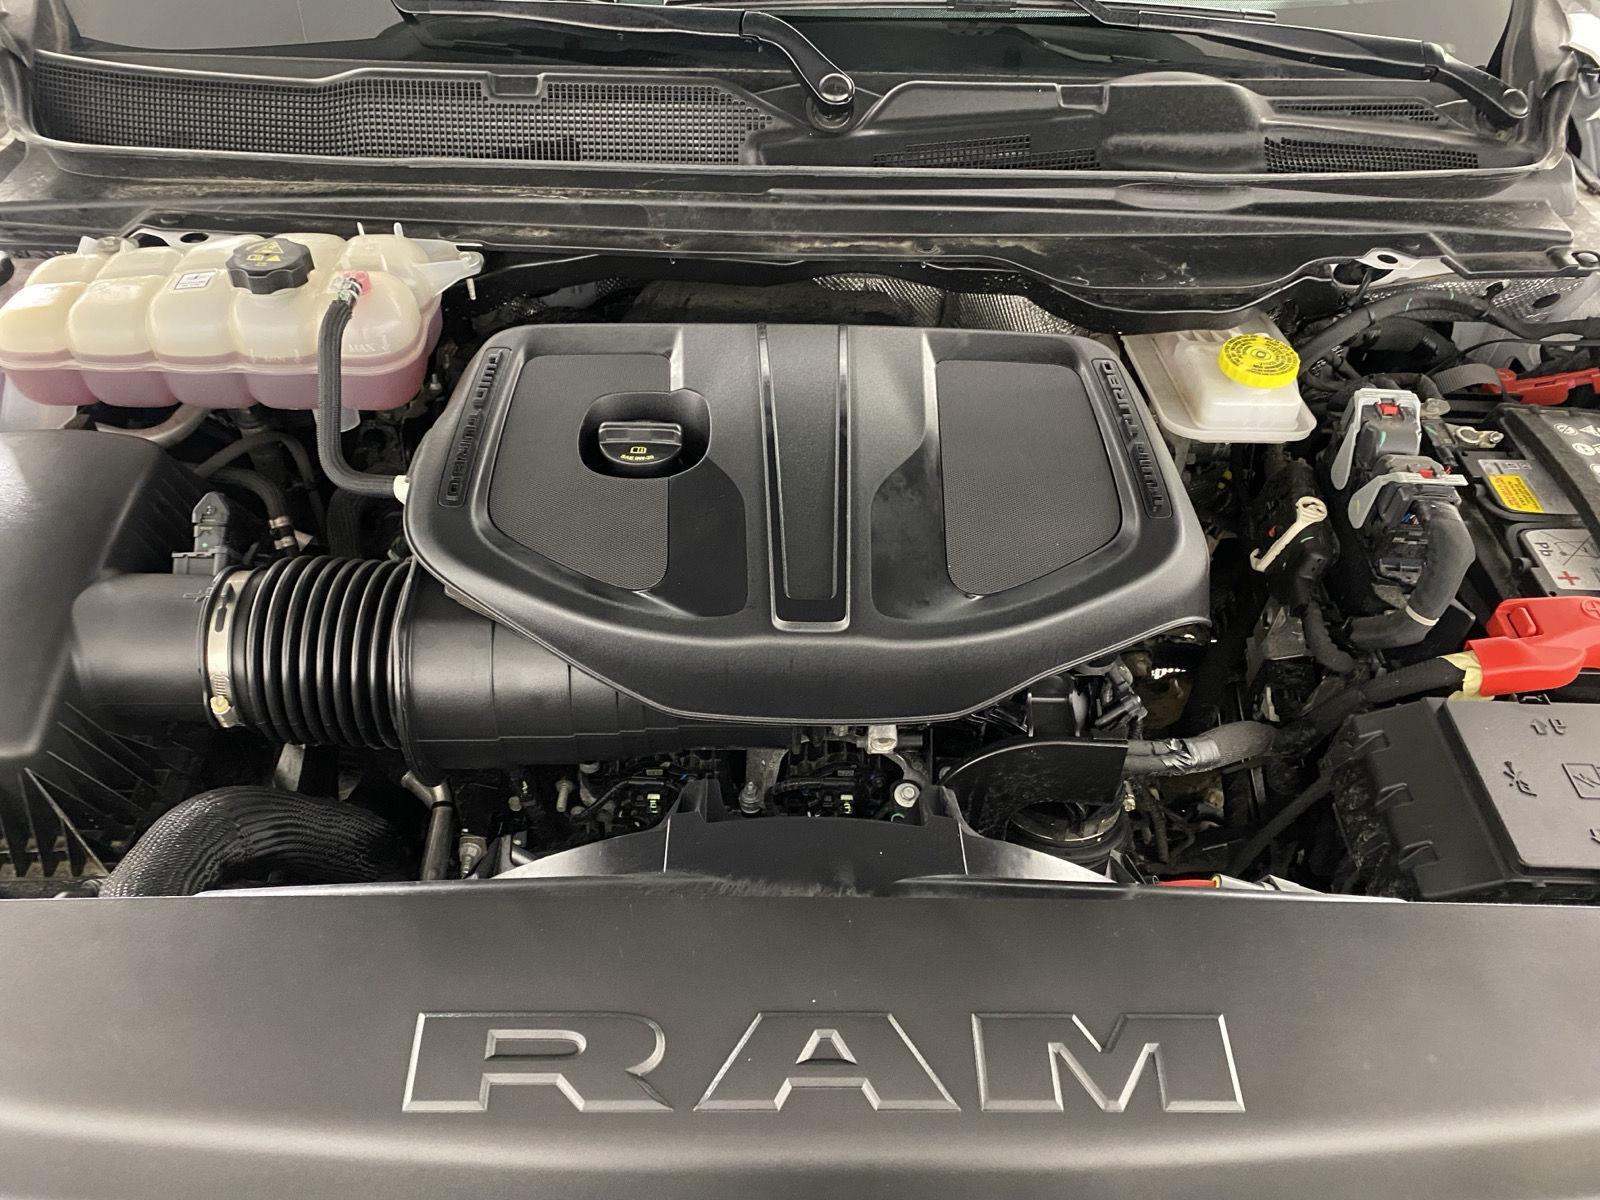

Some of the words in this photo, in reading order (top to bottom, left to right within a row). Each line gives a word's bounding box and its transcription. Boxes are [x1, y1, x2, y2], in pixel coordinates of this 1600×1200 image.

[473, 349, 504, 411] TWIN
[1100, 360, 1139, 442] TURBO
[446, 409, 483, 502] TURBO
[1134, 441, 1165, 513] TWIN
[401, 1011, 1246, 1113] RAM
